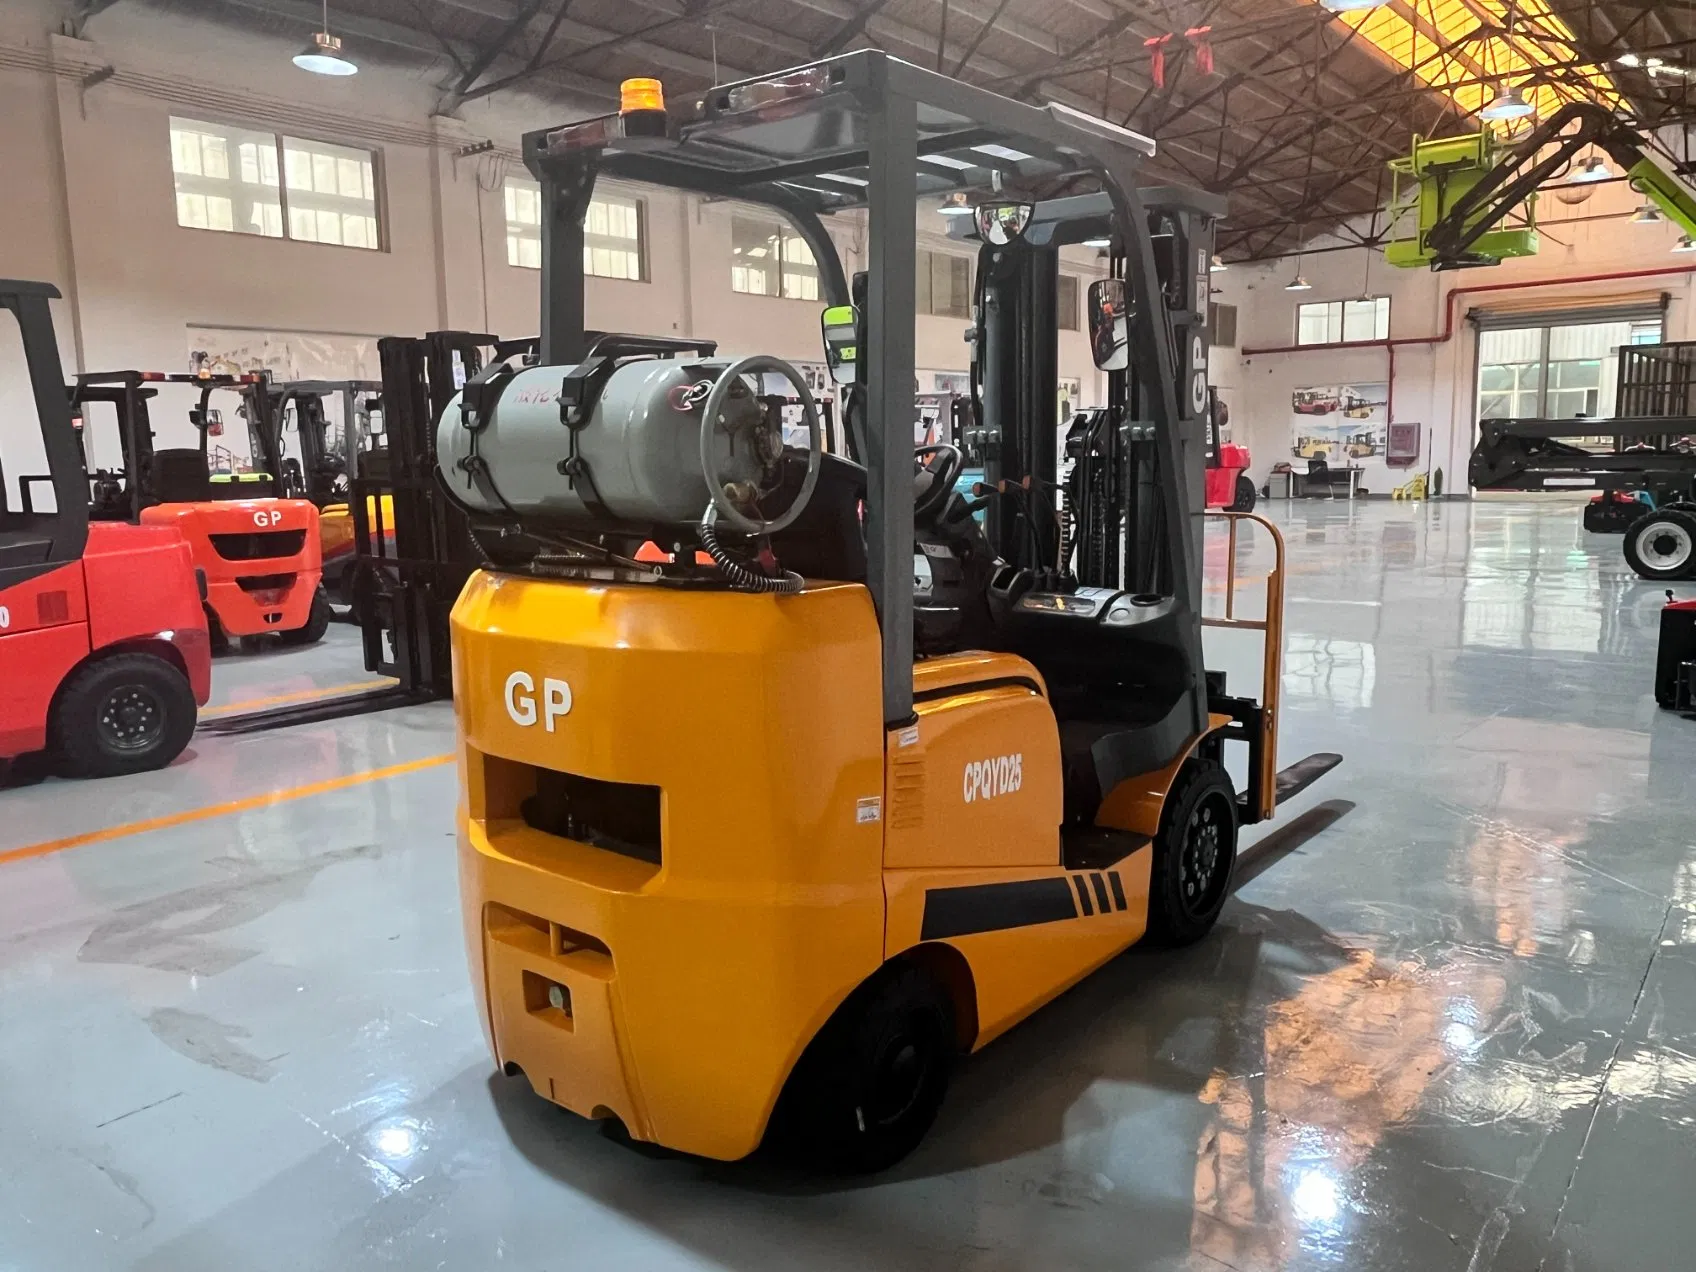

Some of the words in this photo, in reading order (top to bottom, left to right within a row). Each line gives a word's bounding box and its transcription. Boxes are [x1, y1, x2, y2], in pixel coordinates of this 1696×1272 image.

[1193, 336, 1206, 414] GP
[253, 511, 282, 527] GP
[504, 671, 572, 733] GP
[963, 753, 1022, 804] CPQYD25
